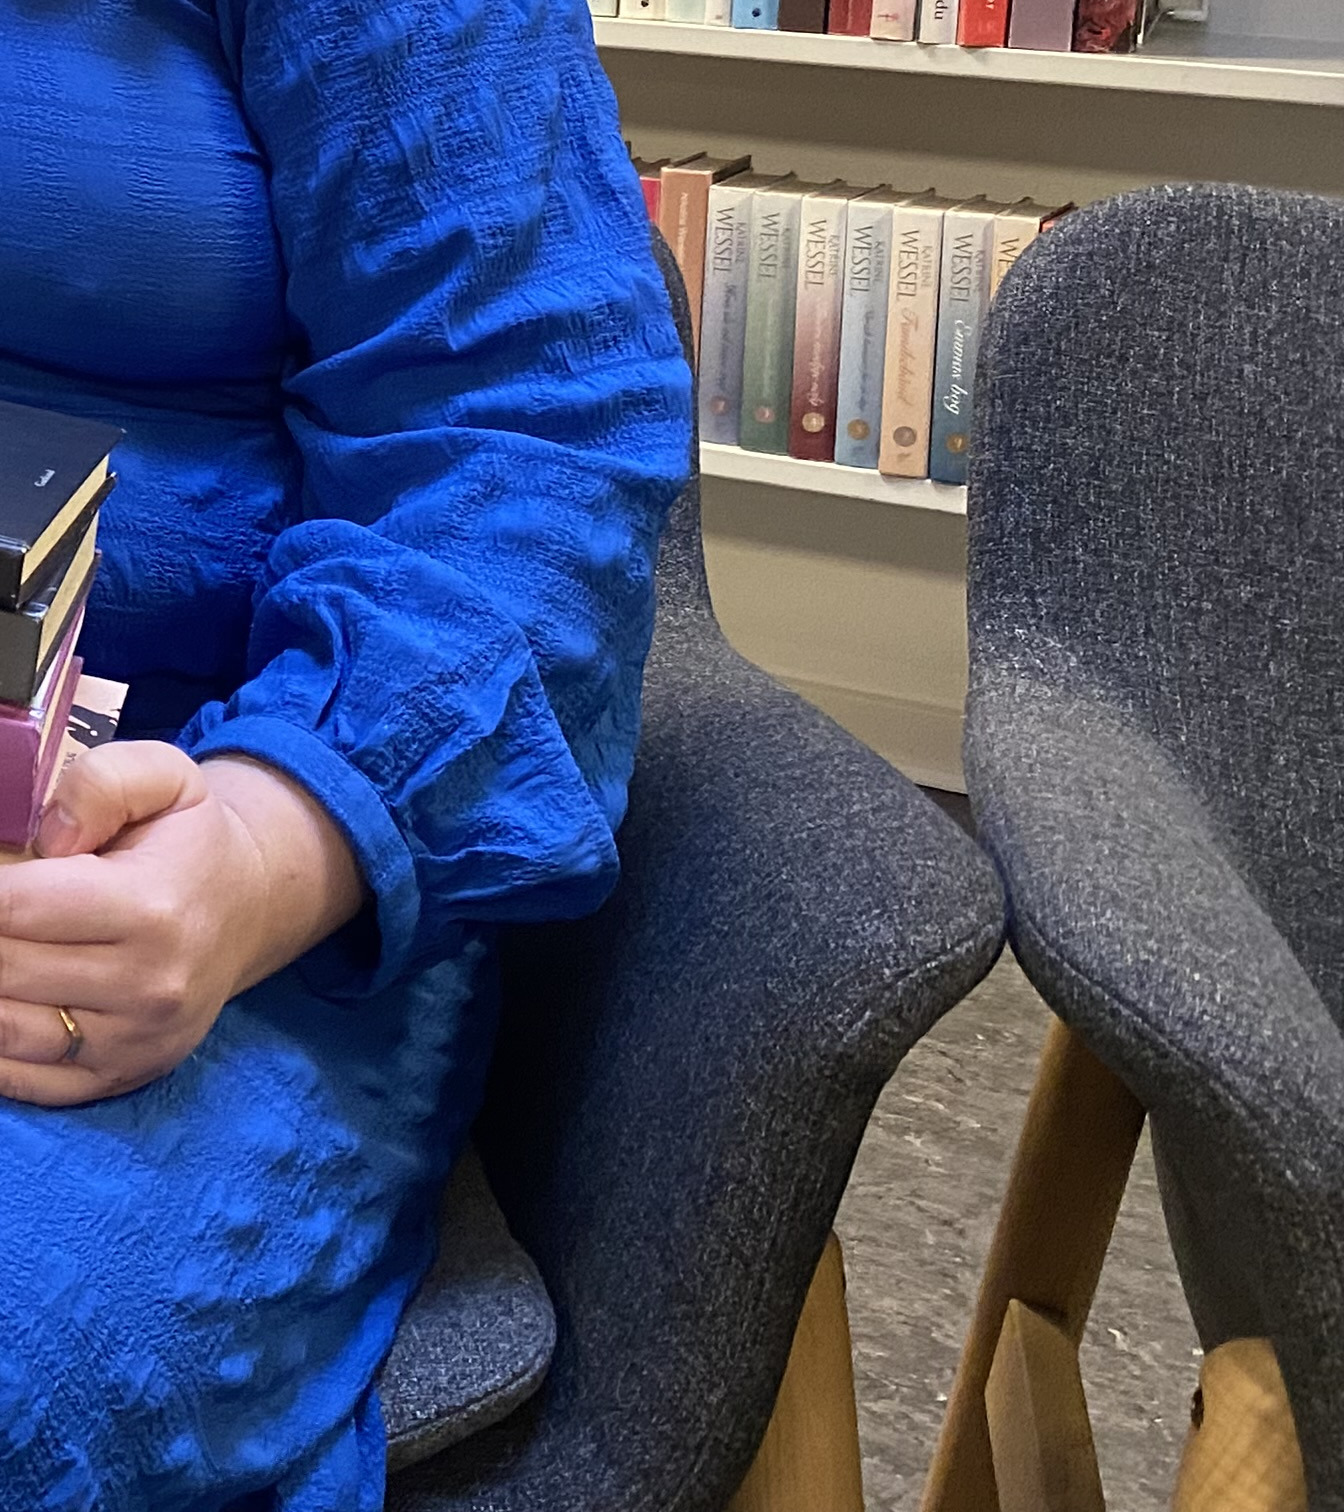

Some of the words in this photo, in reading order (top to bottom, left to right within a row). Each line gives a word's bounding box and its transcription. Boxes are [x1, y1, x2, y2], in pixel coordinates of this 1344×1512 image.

[933, 0, 948, 20] du
[713, 207, 735, 277] WESSEL
[757, 213, 780, 283] WESSEL
[804, 219, 827, 291] WESSEL
[849, 225, 873, 298] WESSEL
[896, 229, 920, 302] WESSEL
[951, 234, 974, 303] WESSEL
